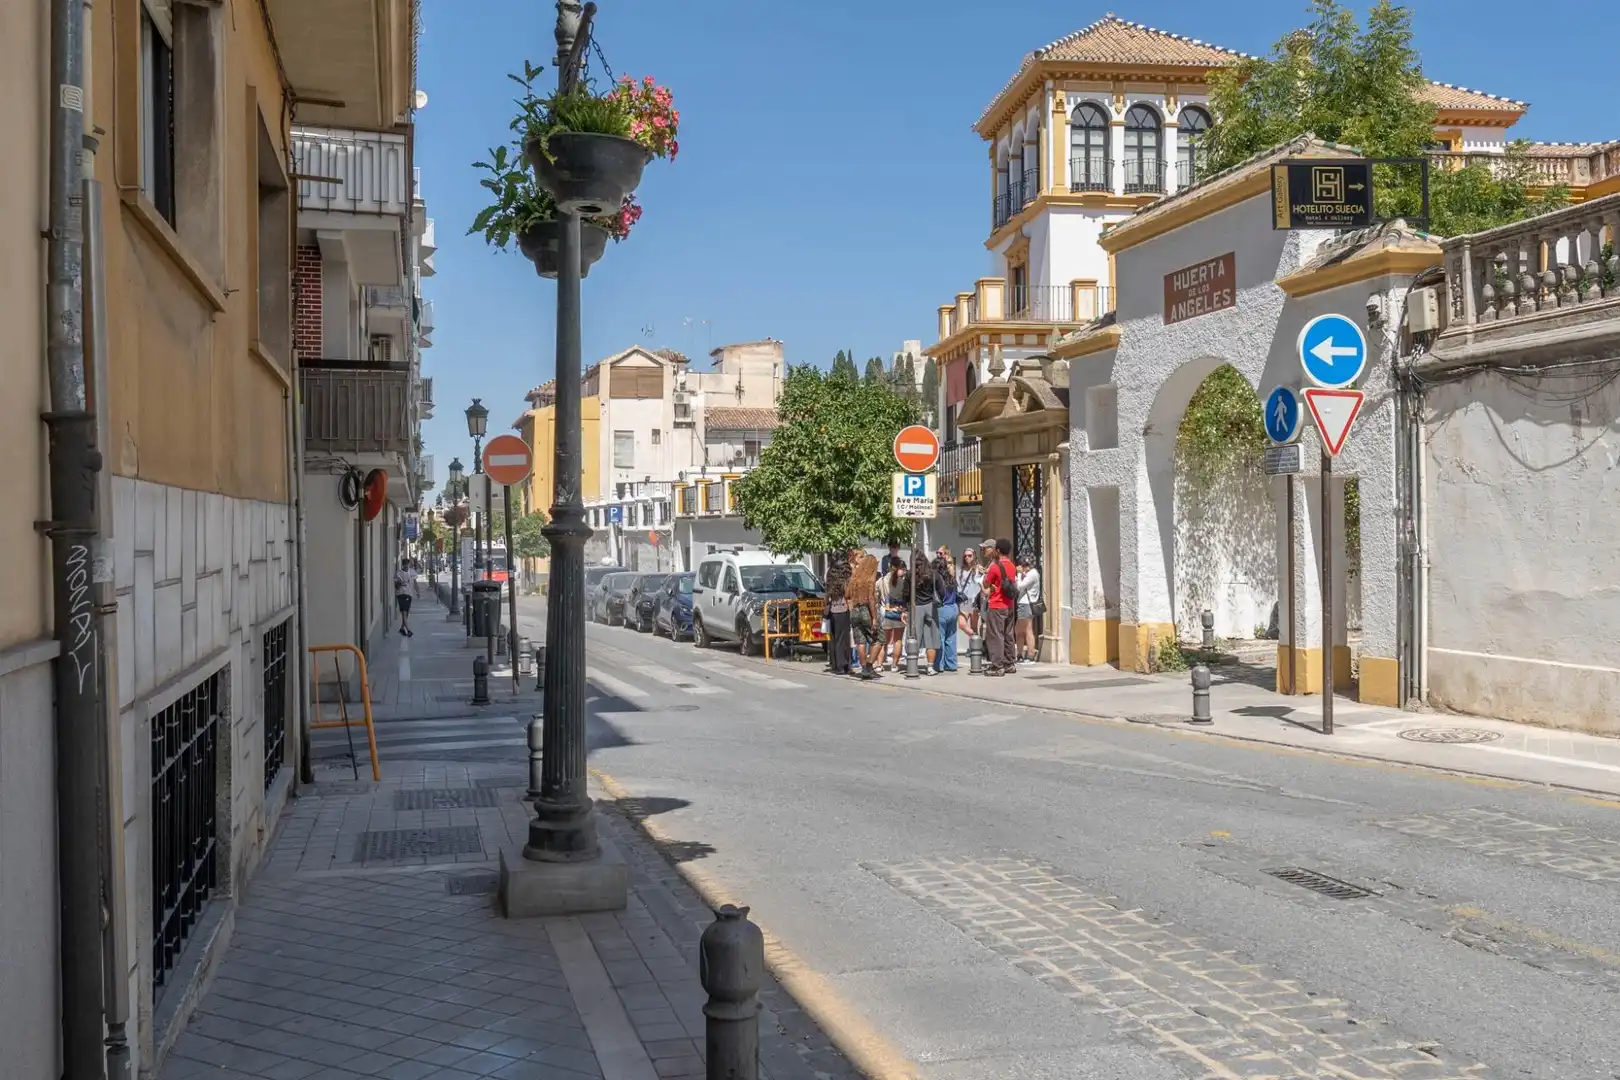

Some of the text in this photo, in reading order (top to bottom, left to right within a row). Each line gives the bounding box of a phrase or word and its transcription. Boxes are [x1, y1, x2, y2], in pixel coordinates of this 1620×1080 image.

[1293, 204, 1365, 213] HOTELITO SUECIA
[1173, 259, 1225, 292] HUERTA
[1188, 283, 1210, 297] DE LOS
[1171, 288, 1232, 321] ANGELES
[907, 476, 922, 495] P
[610, 507, 618, 517] P
